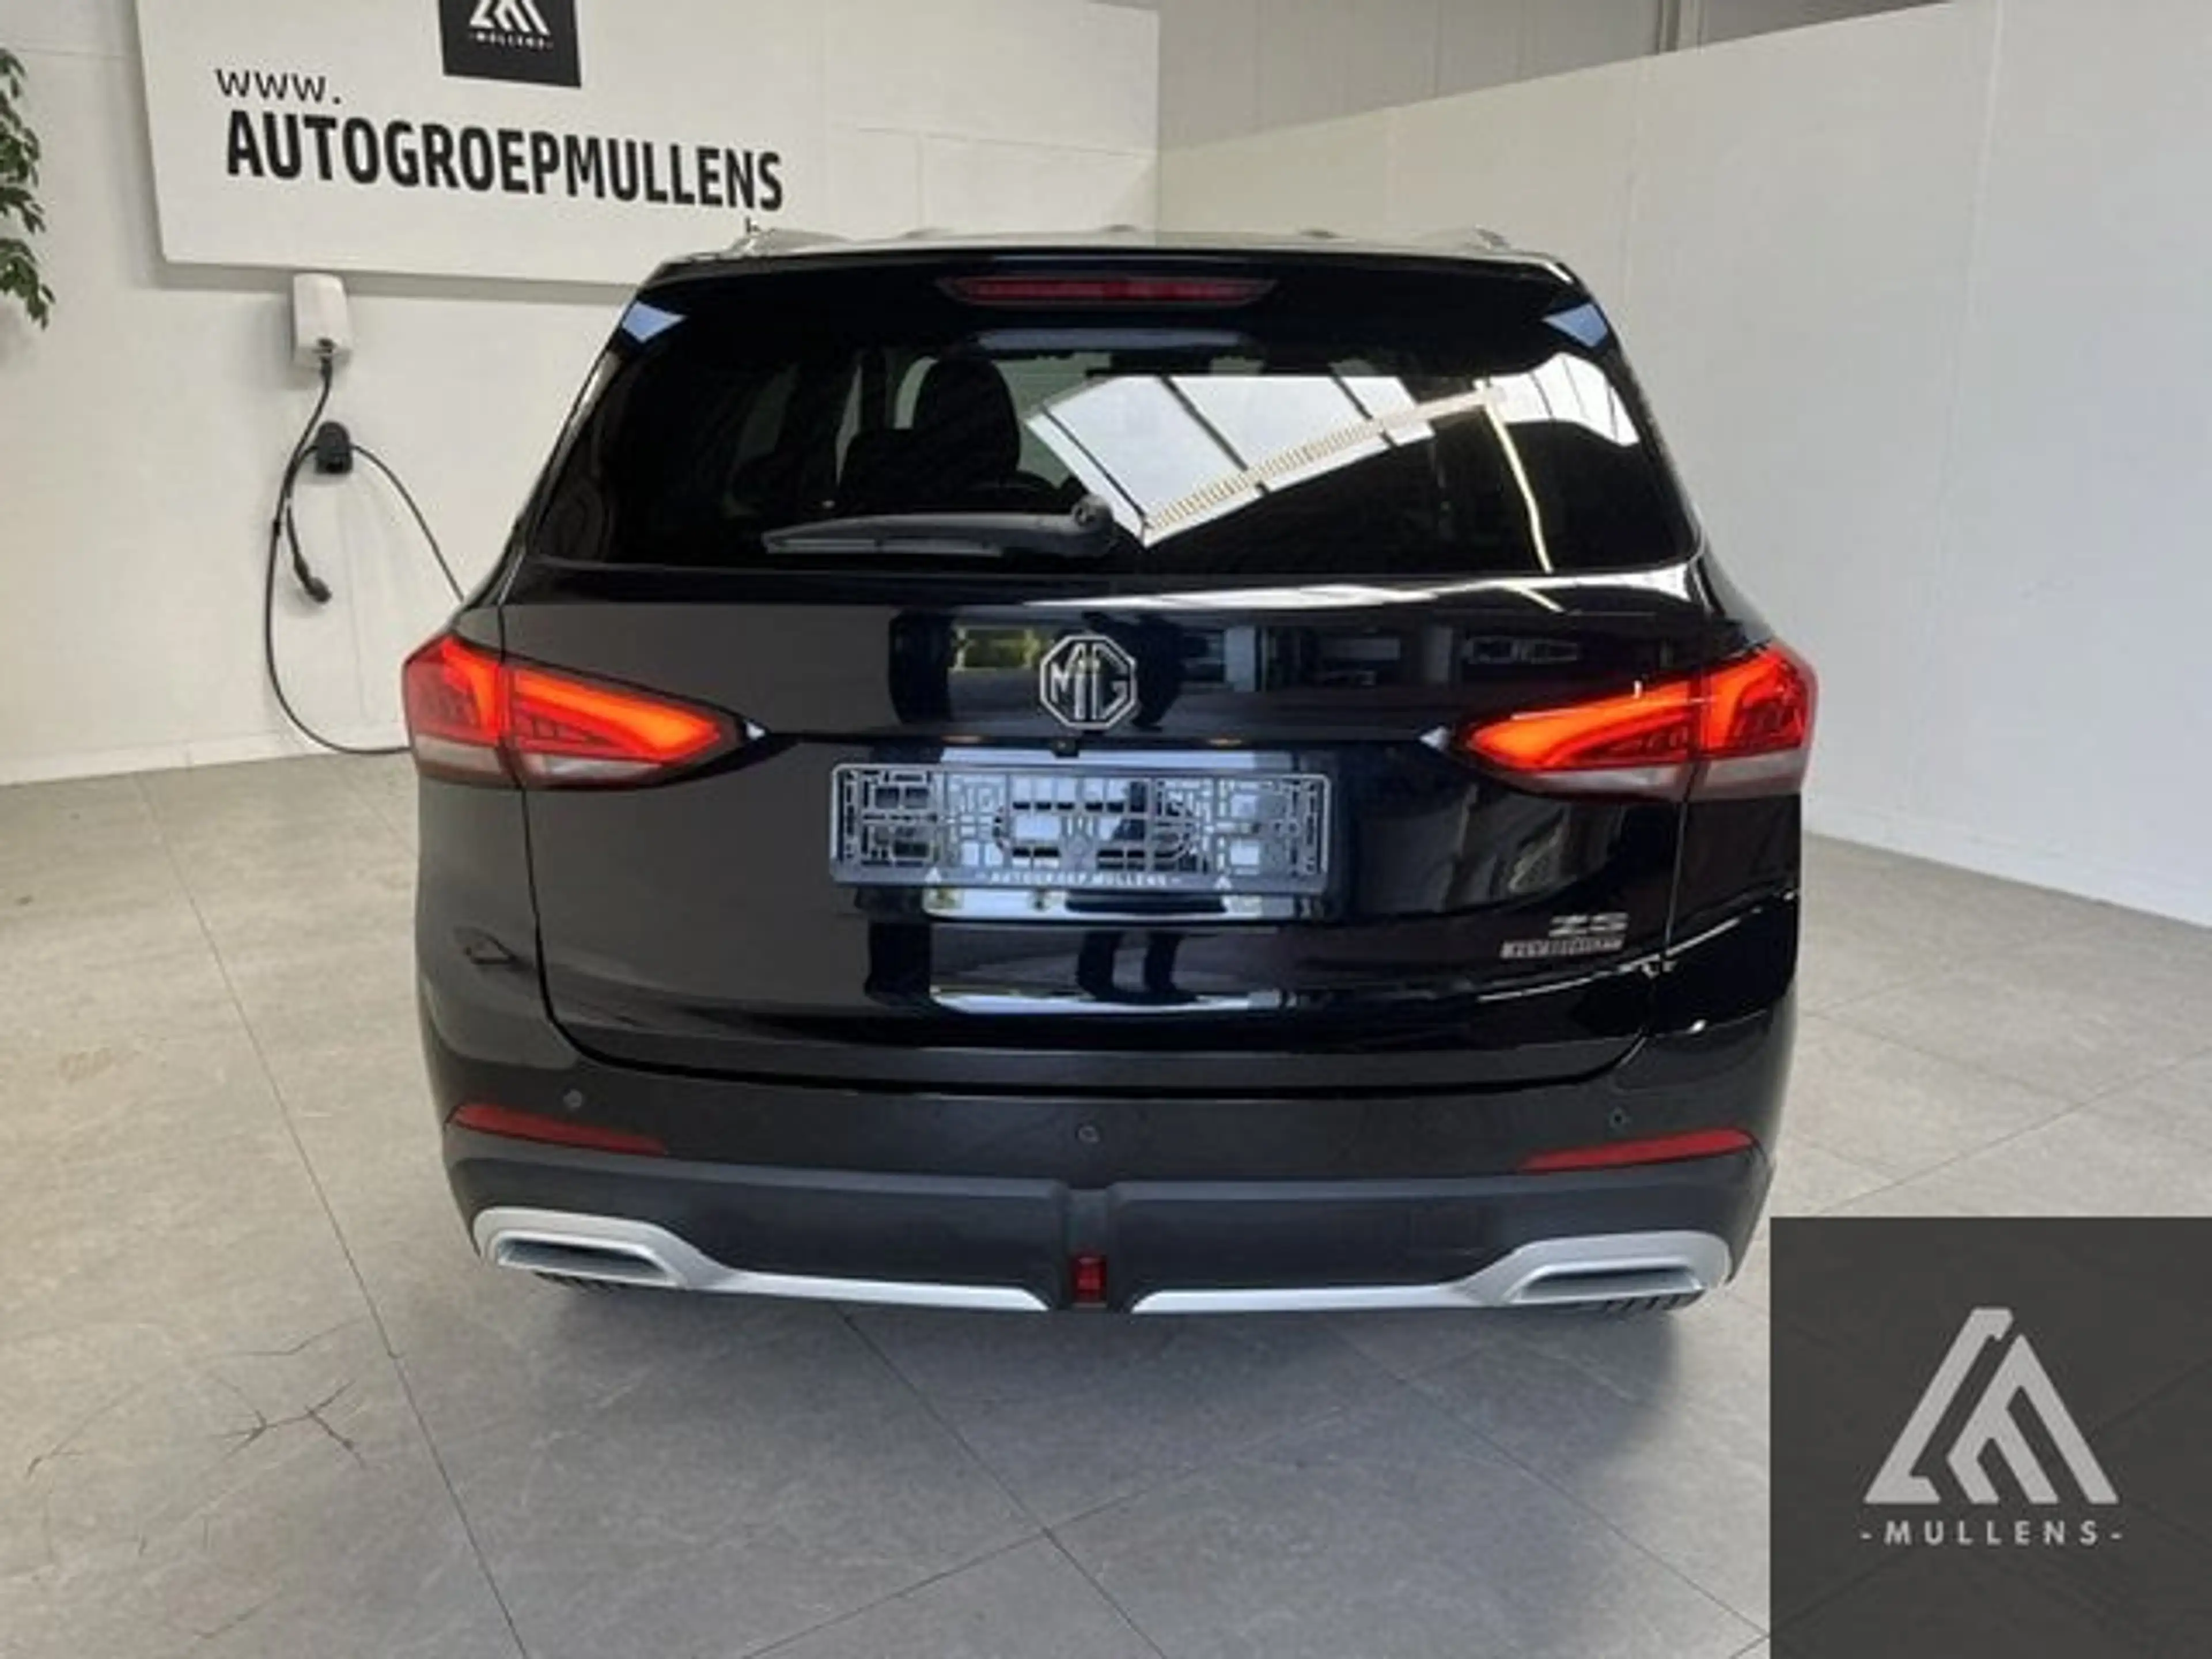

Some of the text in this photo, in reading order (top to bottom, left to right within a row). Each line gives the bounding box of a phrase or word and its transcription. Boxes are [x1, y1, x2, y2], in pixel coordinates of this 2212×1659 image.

[216, 68, 342, 105] www.
[227, 110, 782, 210] AUTOGROEPMULLENS
[1050, 642, 1128, 720] MG
